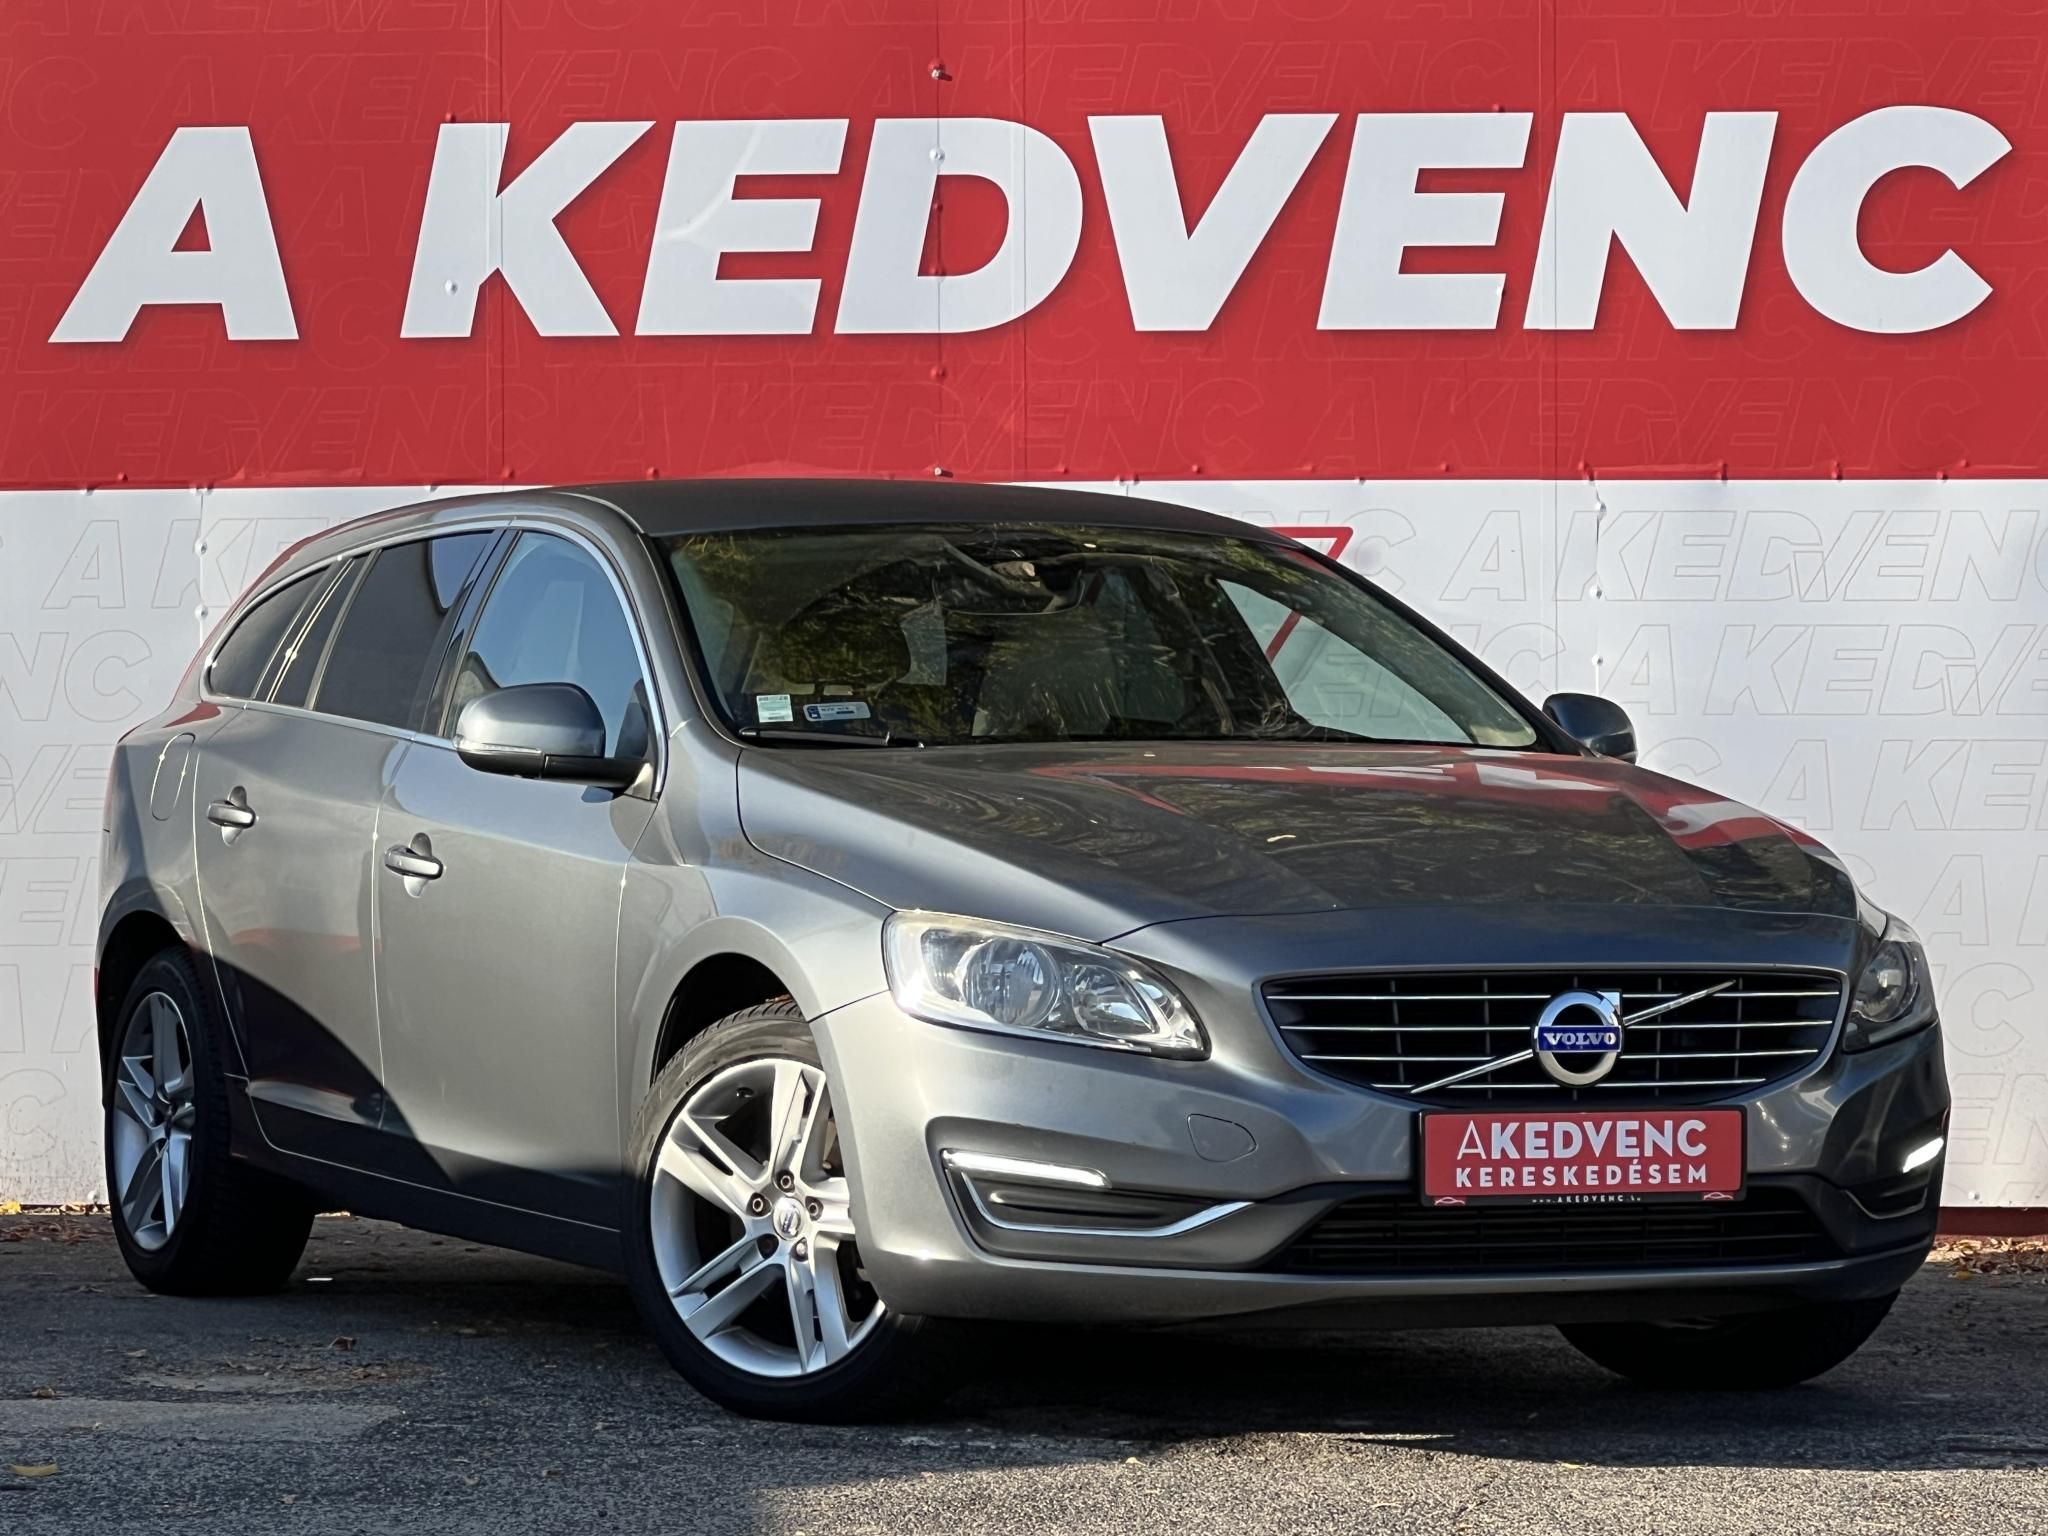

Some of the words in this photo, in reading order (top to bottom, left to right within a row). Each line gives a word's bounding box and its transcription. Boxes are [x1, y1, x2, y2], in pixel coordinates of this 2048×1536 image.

[48, 125, 300, 343] A
[400, 105, 2012, 338] KEDVENC
[1553, 508, 2048, 603] KEDVEN
[1543, 1031, 1617, 1046] VOLVO
[1456, 1160, 1707, 1188] KERESKEDÉSEM
